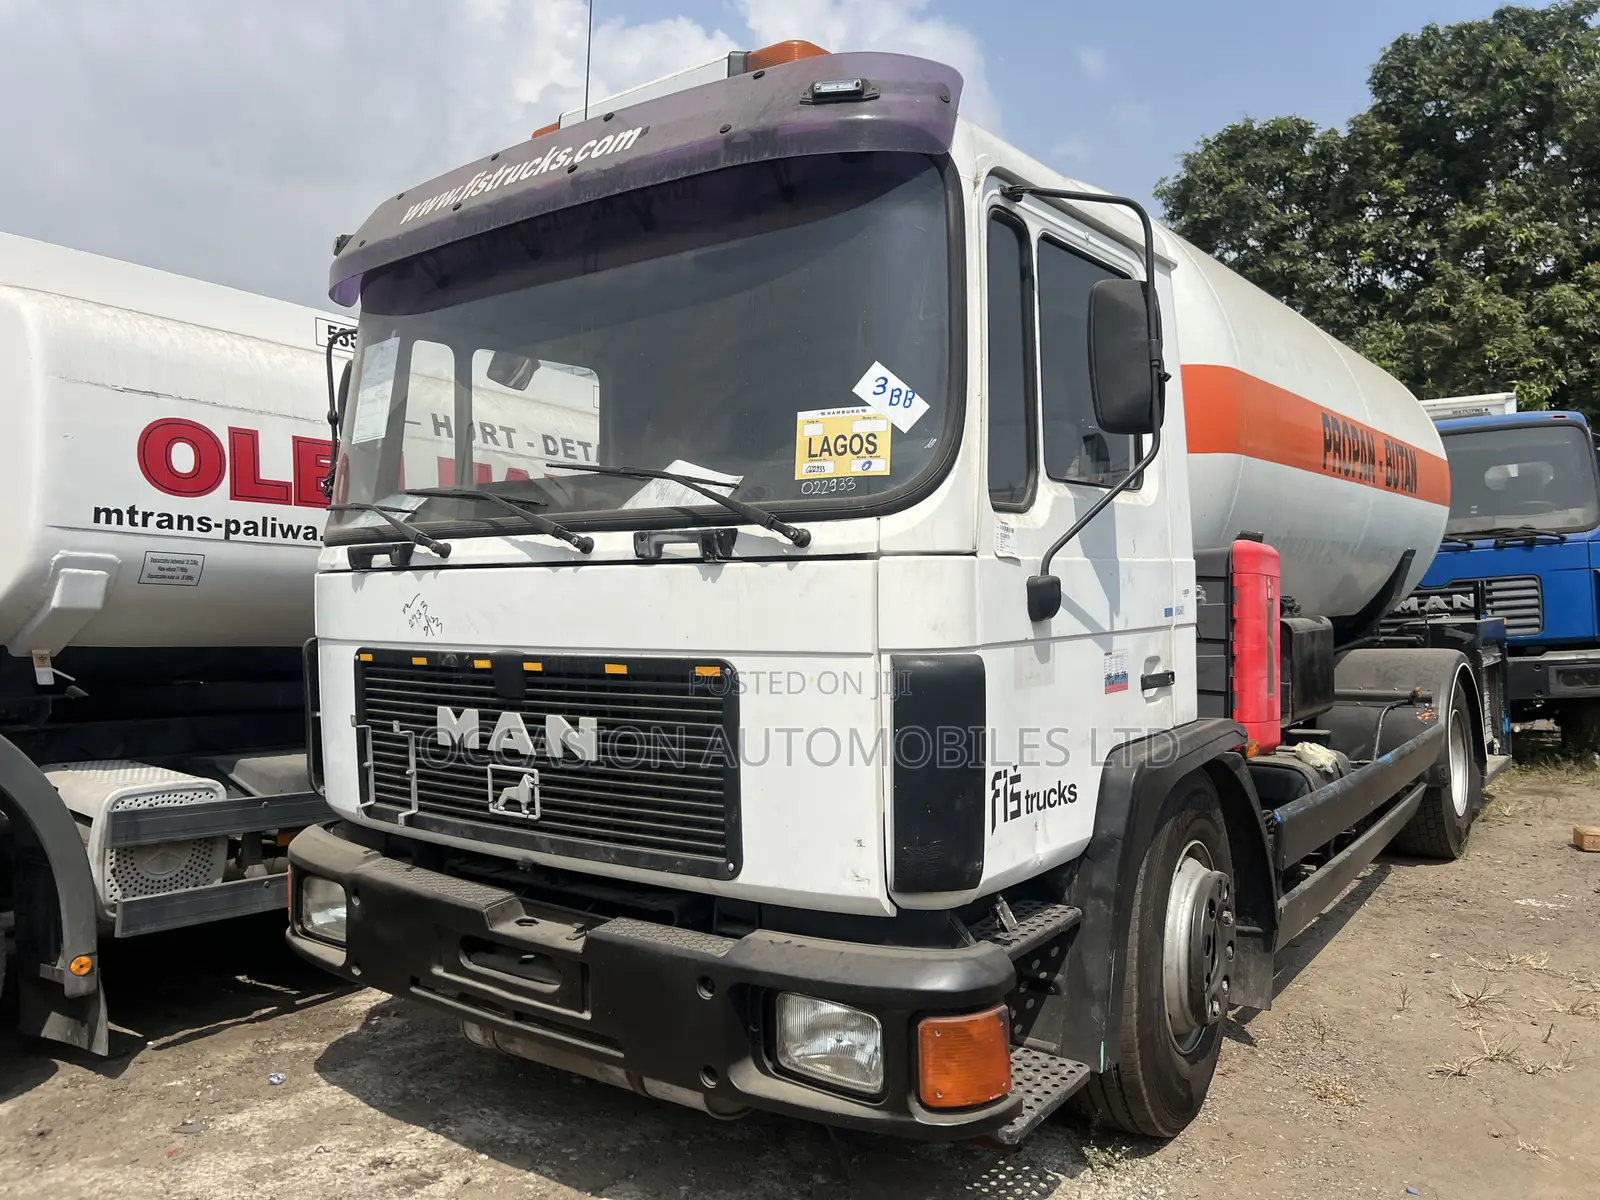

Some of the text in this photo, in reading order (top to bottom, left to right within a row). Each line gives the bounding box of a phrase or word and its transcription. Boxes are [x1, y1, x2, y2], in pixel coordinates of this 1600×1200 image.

[399, 125, 643, 225] www.fistrucks.com
[541, 434, 600, 463] DET
[807, 432, 878, 458] LAGOS
[1321, 412, 1376, 483] PROPAN
[1384, 438, 1418, 494] BUTAN
[801, 477, 857, 495] 022933
[1393, 593, 1475, 613] MAN
[436, 705, 598, 762] MAN
[1024, 780, 1078, 815] trucks
